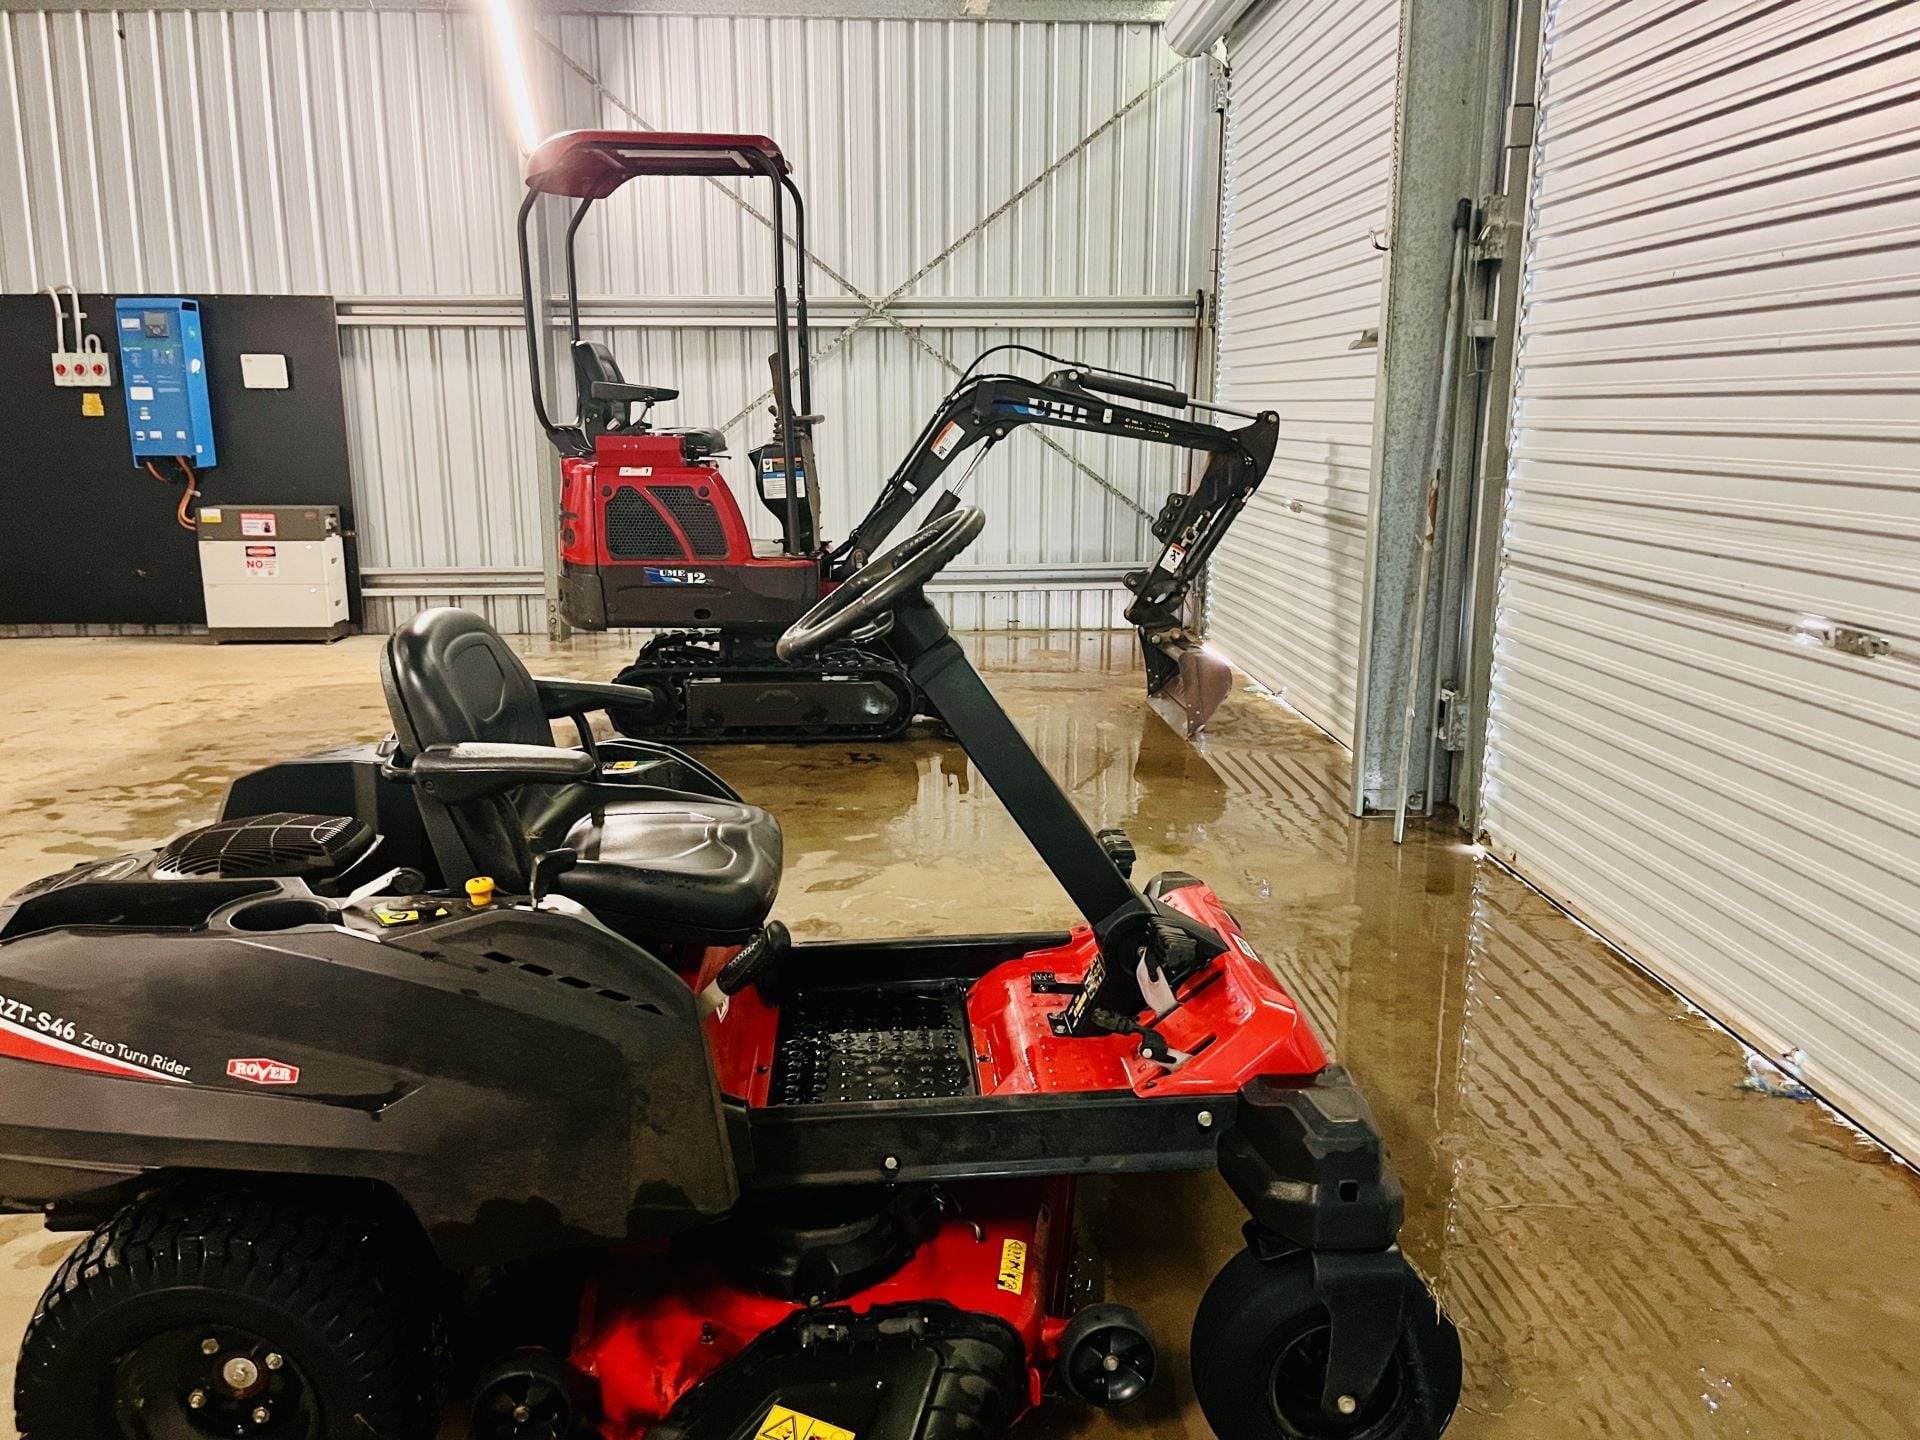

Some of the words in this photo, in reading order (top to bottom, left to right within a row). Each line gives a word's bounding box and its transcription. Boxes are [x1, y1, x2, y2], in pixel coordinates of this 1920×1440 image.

[246, 560, 263, 568] NO
[659, 569, 686, 577] UME
[687, 572, 706, 584] 12
[81, 1032, 115, 1054] Zero
[117, 1043, 149, 1065] Turn
[150, 1054, 191, 1078] Rider
[234, 1061, 291, 1081] ROVER
